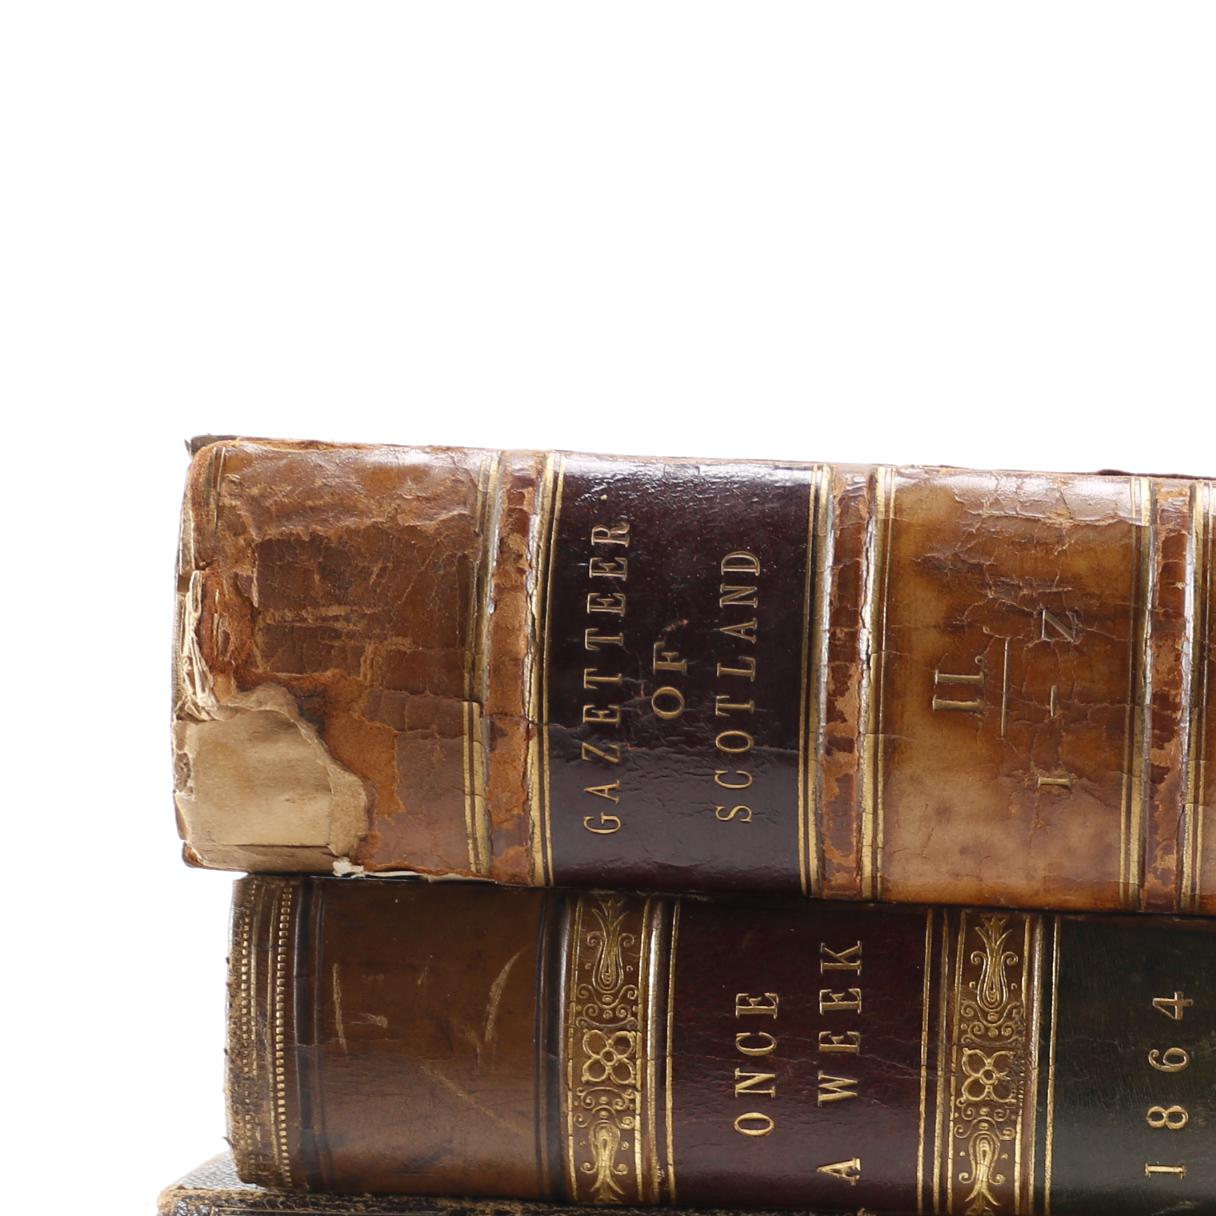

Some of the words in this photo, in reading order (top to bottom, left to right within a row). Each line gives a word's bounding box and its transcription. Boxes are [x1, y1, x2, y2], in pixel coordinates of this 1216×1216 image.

[581, 518, 632, 837] GAZETTEER
[650, 640, 689, 721] OF
[713, 547, 762, 824] SCOTLAND
[732, 991, 781, 1138] ONCE
[816, 939, 863, 1108] WEEK
[1143, 990, 1195, 1183] 1864
[815, 1156, 863, 1187] A
